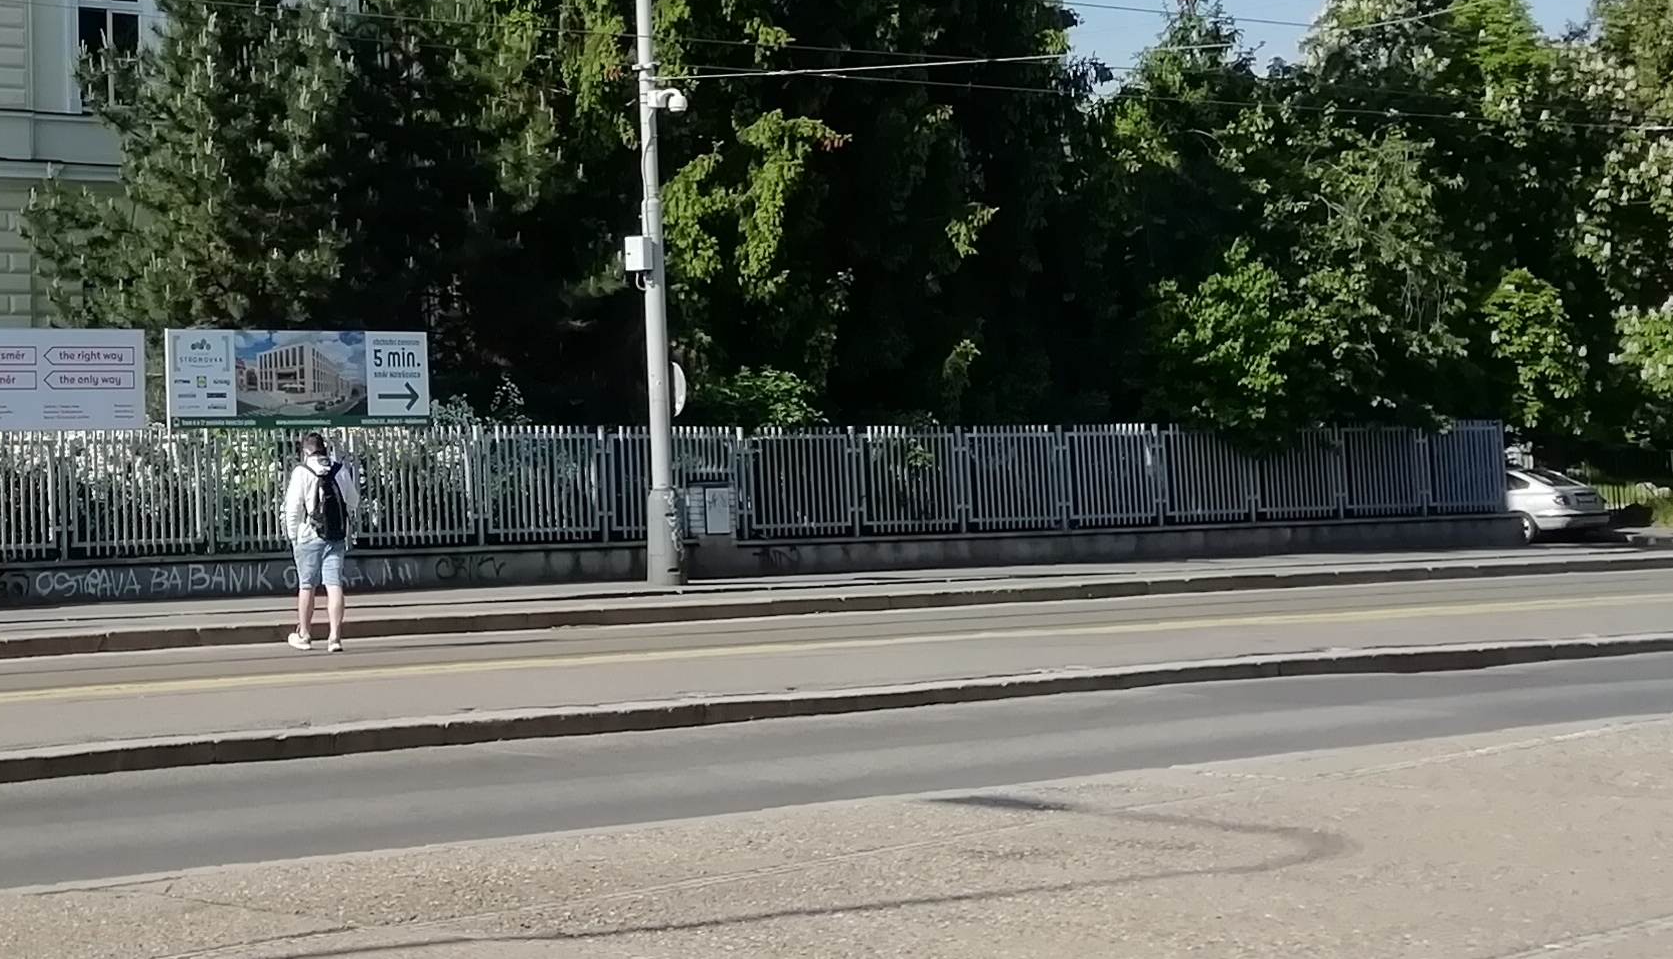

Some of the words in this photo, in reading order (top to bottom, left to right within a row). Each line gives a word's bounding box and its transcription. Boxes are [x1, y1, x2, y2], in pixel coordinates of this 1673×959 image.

[1, 350, 25, 360] směr
[59, 350, 75, 360] the
[77, 350, 101, 361] right
[103, 352, 123, 361] way
[374, 348, 383, 367] 5
[388, 347, 421, 367] min.
[59, 375, 75, 385] the
[78, 375, 98, 386] only
[101, 376, 121, 386] way
